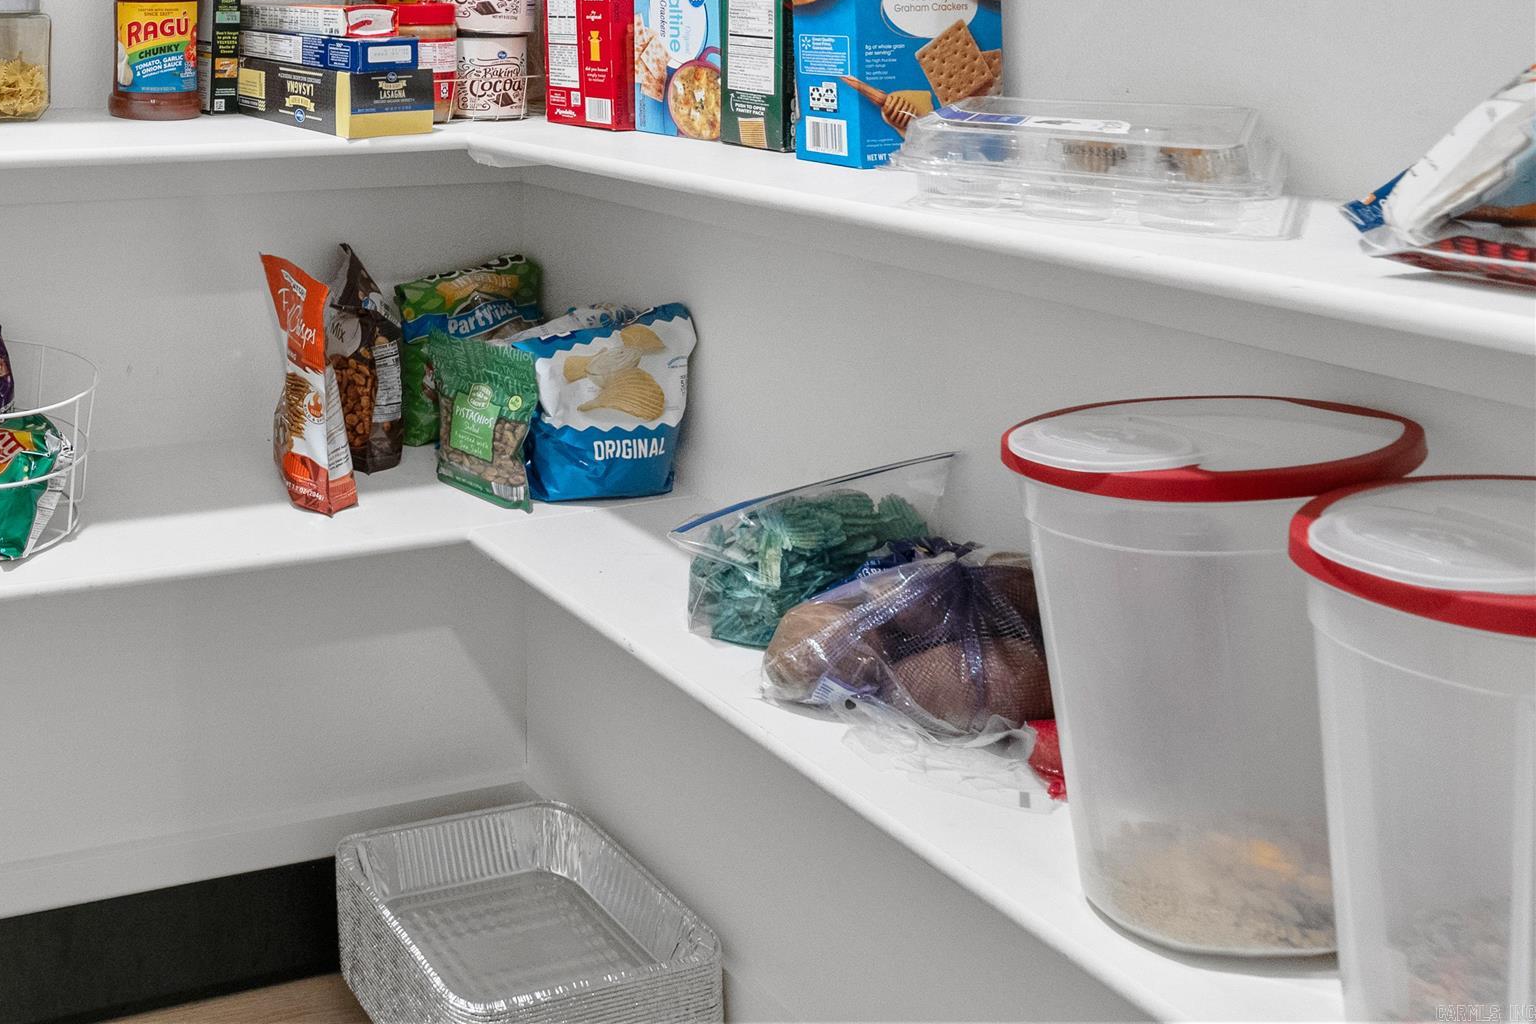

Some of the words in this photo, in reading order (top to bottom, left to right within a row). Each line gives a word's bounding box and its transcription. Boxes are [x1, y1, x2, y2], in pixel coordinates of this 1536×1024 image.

[894, 3, 930, 13] Graham
[931, 2, 968, 12] Crackers
[657, 0, 667, 38] Crackers
[127, 11, 189, 49] RAGÚ
[138, 43, 180, 60] CHUNKY
[135, 58, 162, 71] TOMATO,
[163, 55, 184, 63] GARLIC
[141, 65, 162, 74] ONION
[163, 60, 183, 69] SAUCE
[483, 67, 520, 78] Baking
[287, 80, 314, 96] LASAGNA
[379, 90, 406, 100] LASAGNA
[469, 78, 522, 98] Cocoa
[447, 304, 494, 335] Party
[455, 406, 494, 428] PISTACHIOS
[593, 437, 665, 461] ORIGINAL
